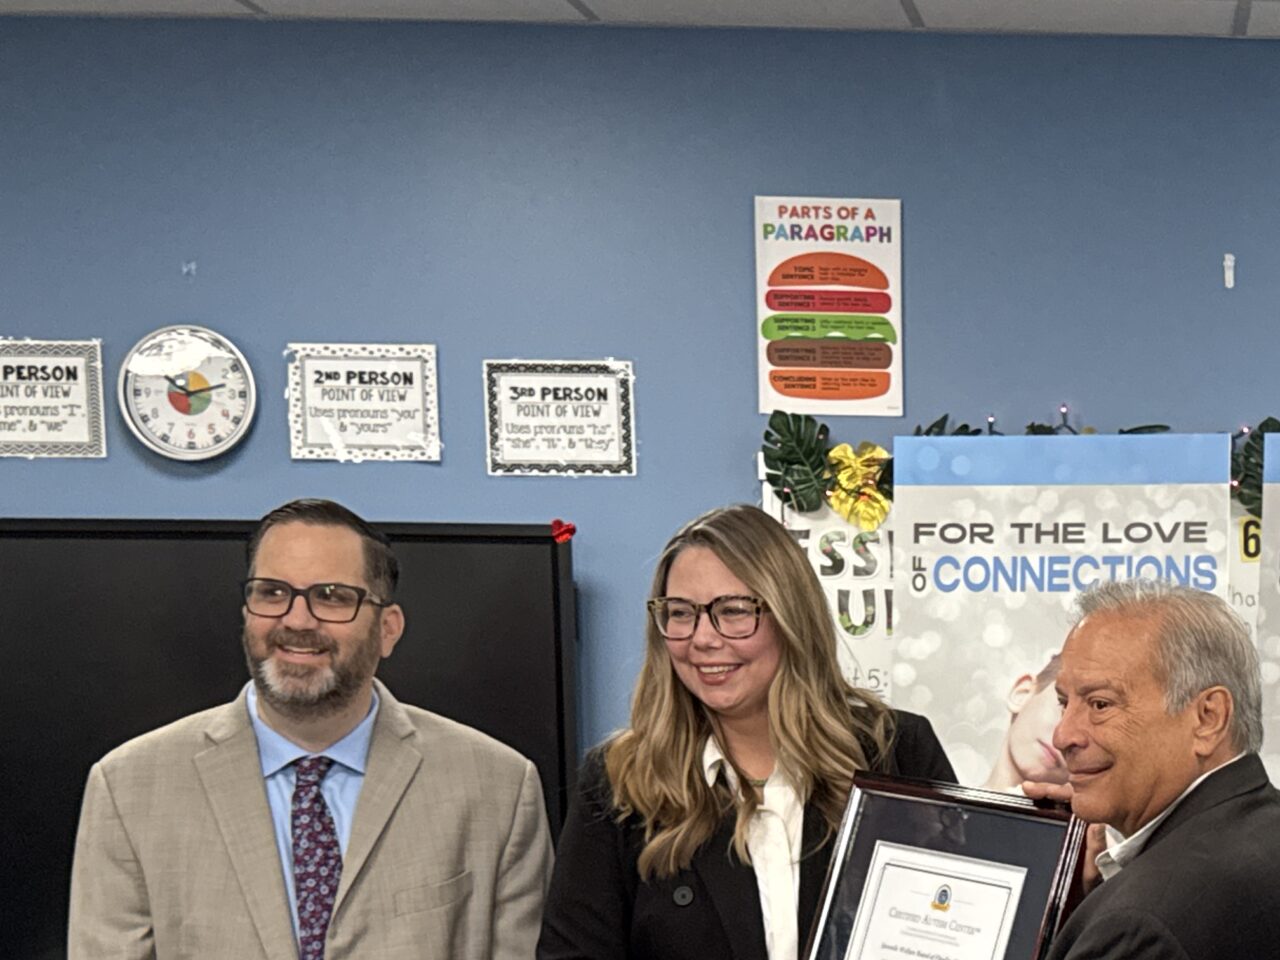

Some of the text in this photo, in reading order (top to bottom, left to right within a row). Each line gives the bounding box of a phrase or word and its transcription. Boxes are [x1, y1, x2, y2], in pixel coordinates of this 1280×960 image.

[778, 205, 876, 221] PARTS OF A
[762, 223, 892, 243] PARAGRAPH
[3, 365, 78, 381] PERSON
[314, 370, 414, 385] 2ND PERSON
[0, 385, 71, 398] INT OF VIEW
[144, 387, 151, 398] 9
[228, 389, 236, 400] 3
[321, 388, 408, 402] POINT OF VIEW
[509, 386, 608, 401] 3RD PERSON
[3, 405, 60, 418] pronouns
[337, 408, 389, 420] pronouns
[516, 404, 602, 418] POINT OF VIEW
[187, 429, 195, 439] 6
[208, 423, 215, 434] 5
[913, 521, 1208, 544] FOR THE LOVE
[1243, 520, 1261, 558] 6
[912, 554, 1217, 593] OF CONNECTIONS
